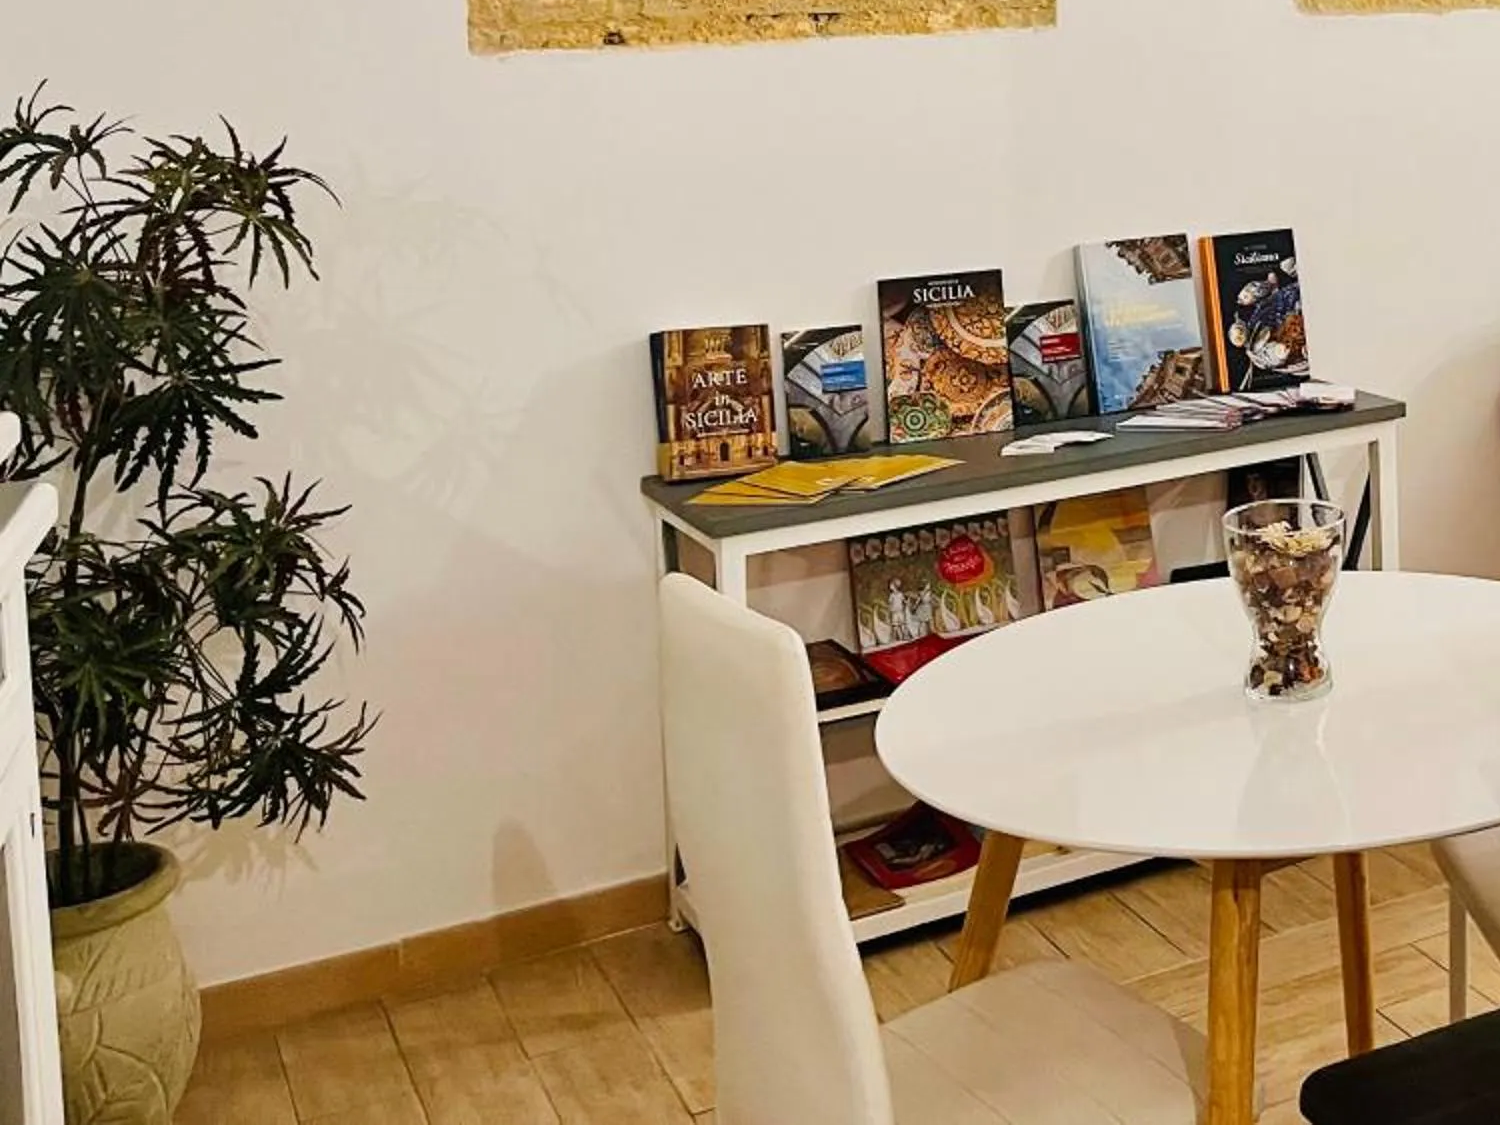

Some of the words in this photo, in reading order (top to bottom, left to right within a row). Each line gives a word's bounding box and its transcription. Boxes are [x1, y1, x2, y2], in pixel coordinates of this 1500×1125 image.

[913, 285, 976, 304] SICILIA
[692, 368, 748, 389] ARTE
[685, 407, 758, 429] SICILIA
